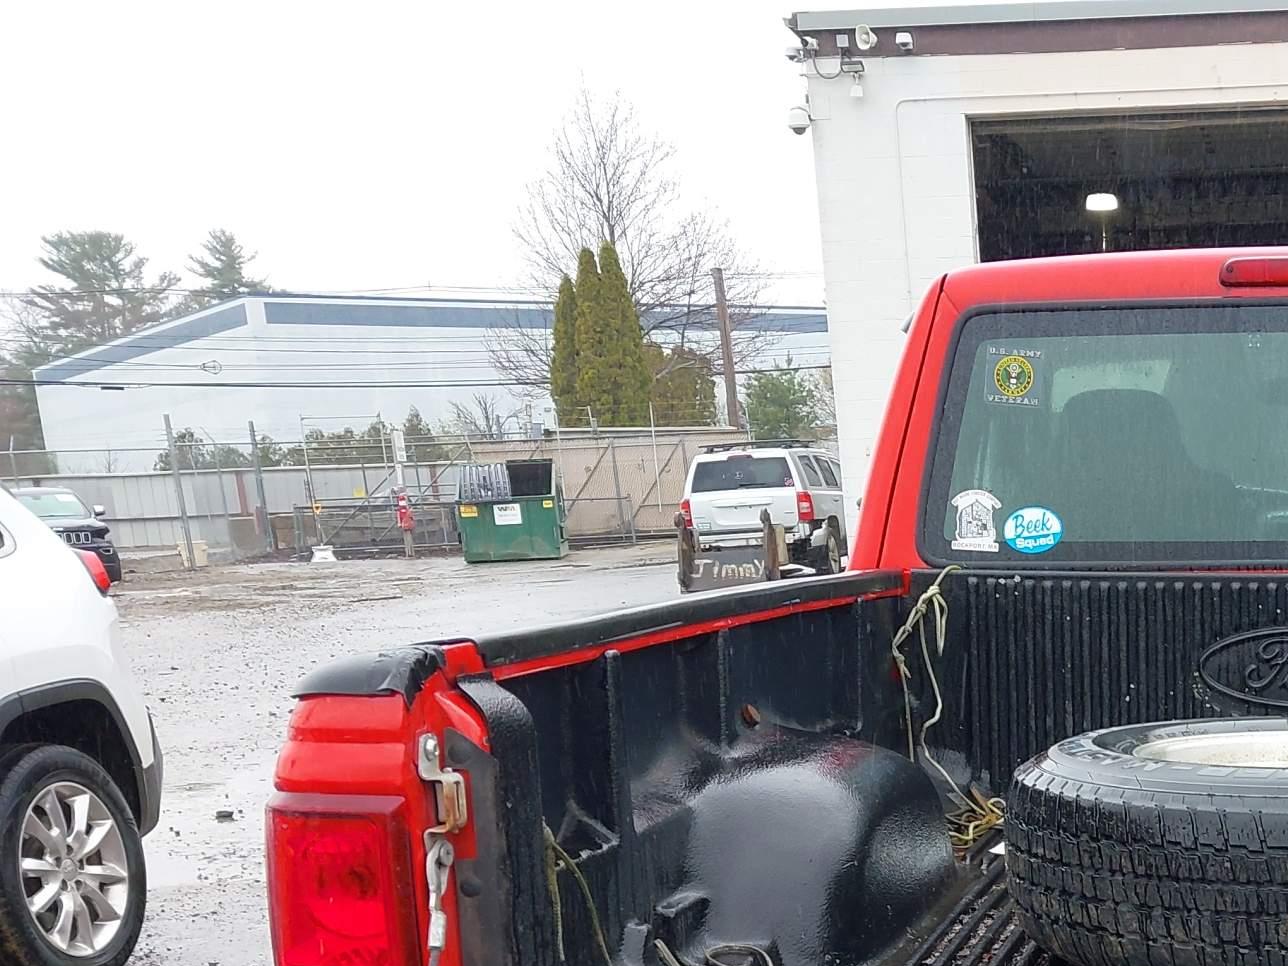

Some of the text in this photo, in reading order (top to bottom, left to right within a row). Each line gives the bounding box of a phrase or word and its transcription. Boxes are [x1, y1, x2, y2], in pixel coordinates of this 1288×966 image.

[1012, 349, 1041, 358] ARMY
[987, 394, 1038, 405] VETERAN
[1012, 511, 1053, 536] Beek
[1015, 534, 1055, 549] Squad
